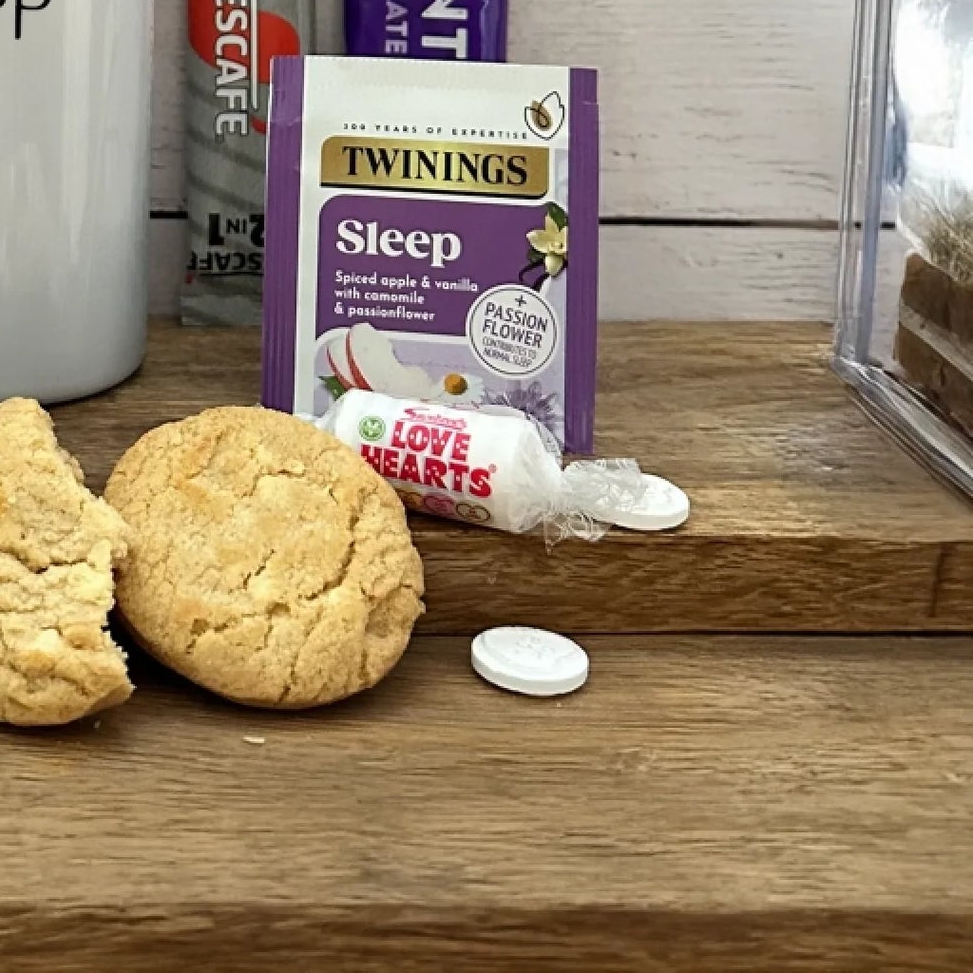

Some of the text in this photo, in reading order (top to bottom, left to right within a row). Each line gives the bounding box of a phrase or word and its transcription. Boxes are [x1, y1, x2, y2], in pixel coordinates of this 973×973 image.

[375, 124, 417, 134] YEARS
[426, 126, 442, 135] OF
[452, 128, 528, 140] EXPERTISE
[342, 146, 528, 186] TWININGS
[209, 213, 224, 246] 1
[226, 218, 247, 235] IN
[336, 219, 462, 268] Sleep
[334, 286, 425, 304] with camomile
[335, 270, 478, 292] Spiced apple & vanilla
[334, 302, 435, 321] & passionflower
[485, 301, 548, 333] PASSION
[483, 318, 542, 348] FLOWER
[391, 420, 472, 462] LOVE
[361, 444, 492, 499] HEARTS
